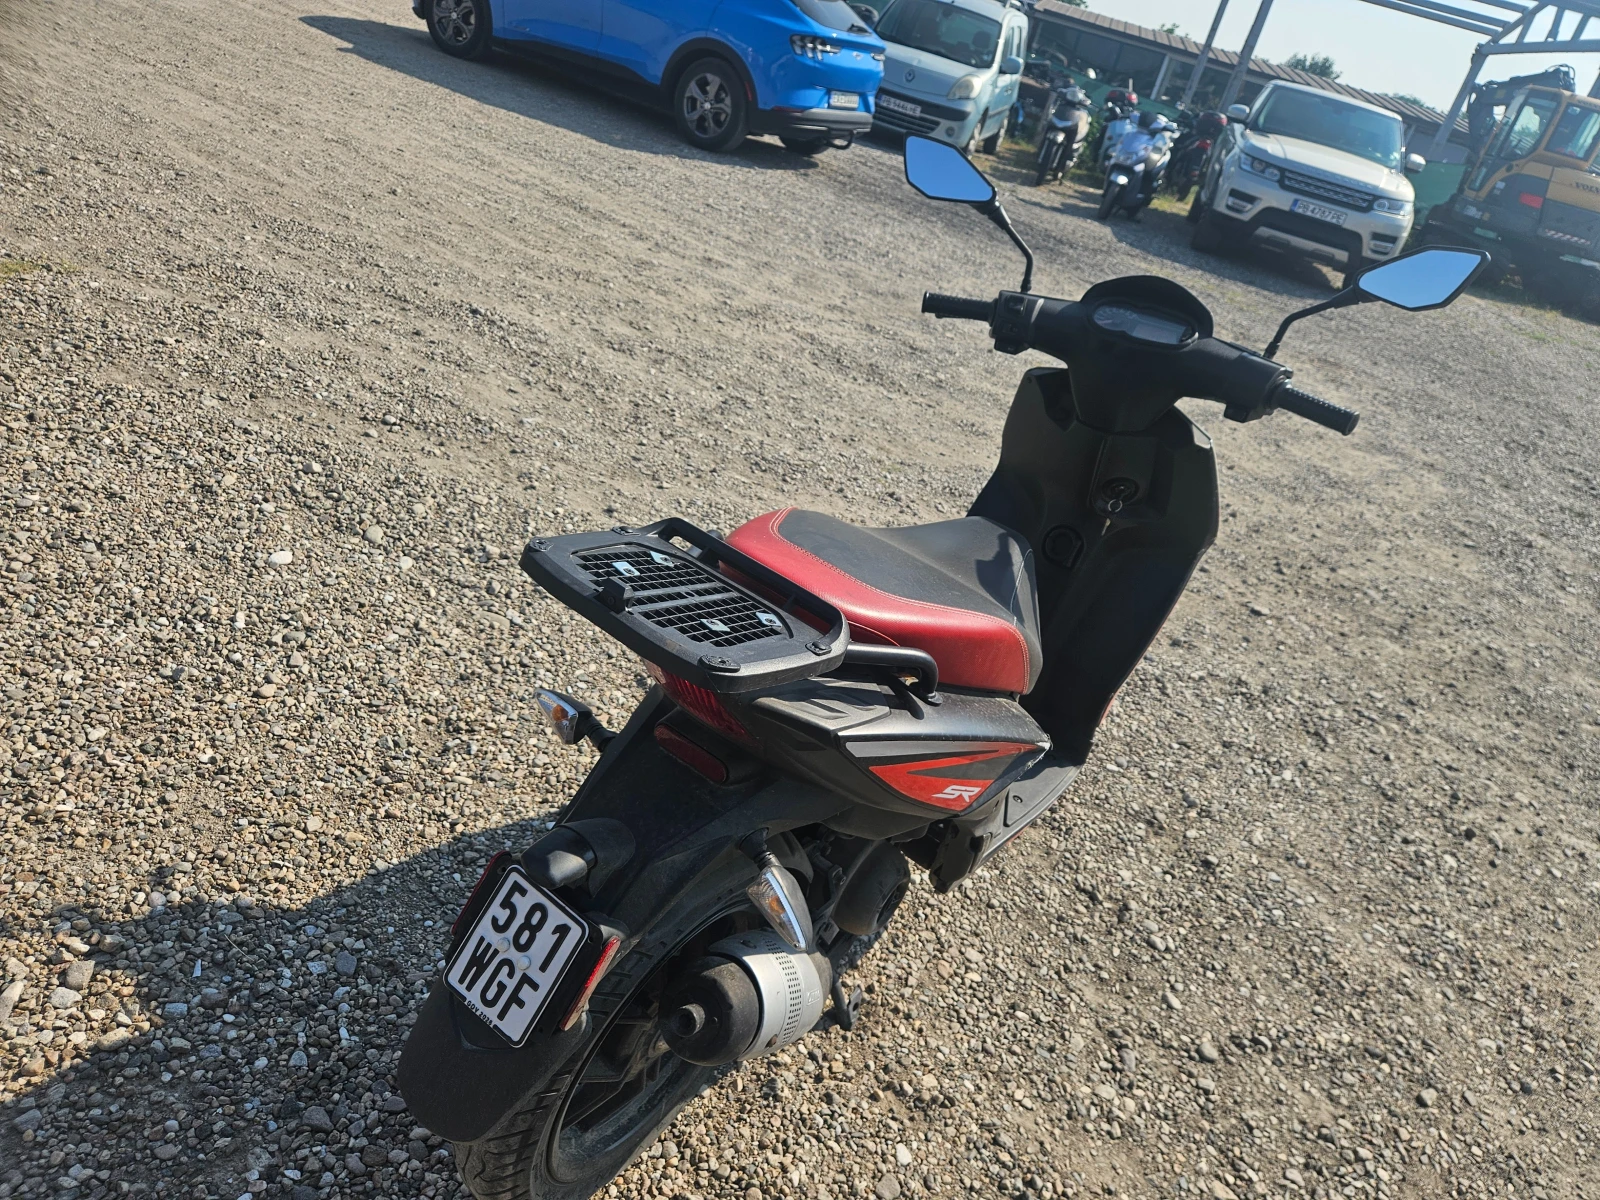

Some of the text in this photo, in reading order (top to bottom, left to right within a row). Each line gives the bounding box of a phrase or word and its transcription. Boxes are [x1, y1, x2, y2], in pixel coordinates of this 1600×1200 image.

[931, 785, 982, 803] SR
[490, 879, 572, 974] 581
[457, 935, 540, 1022] WGF
